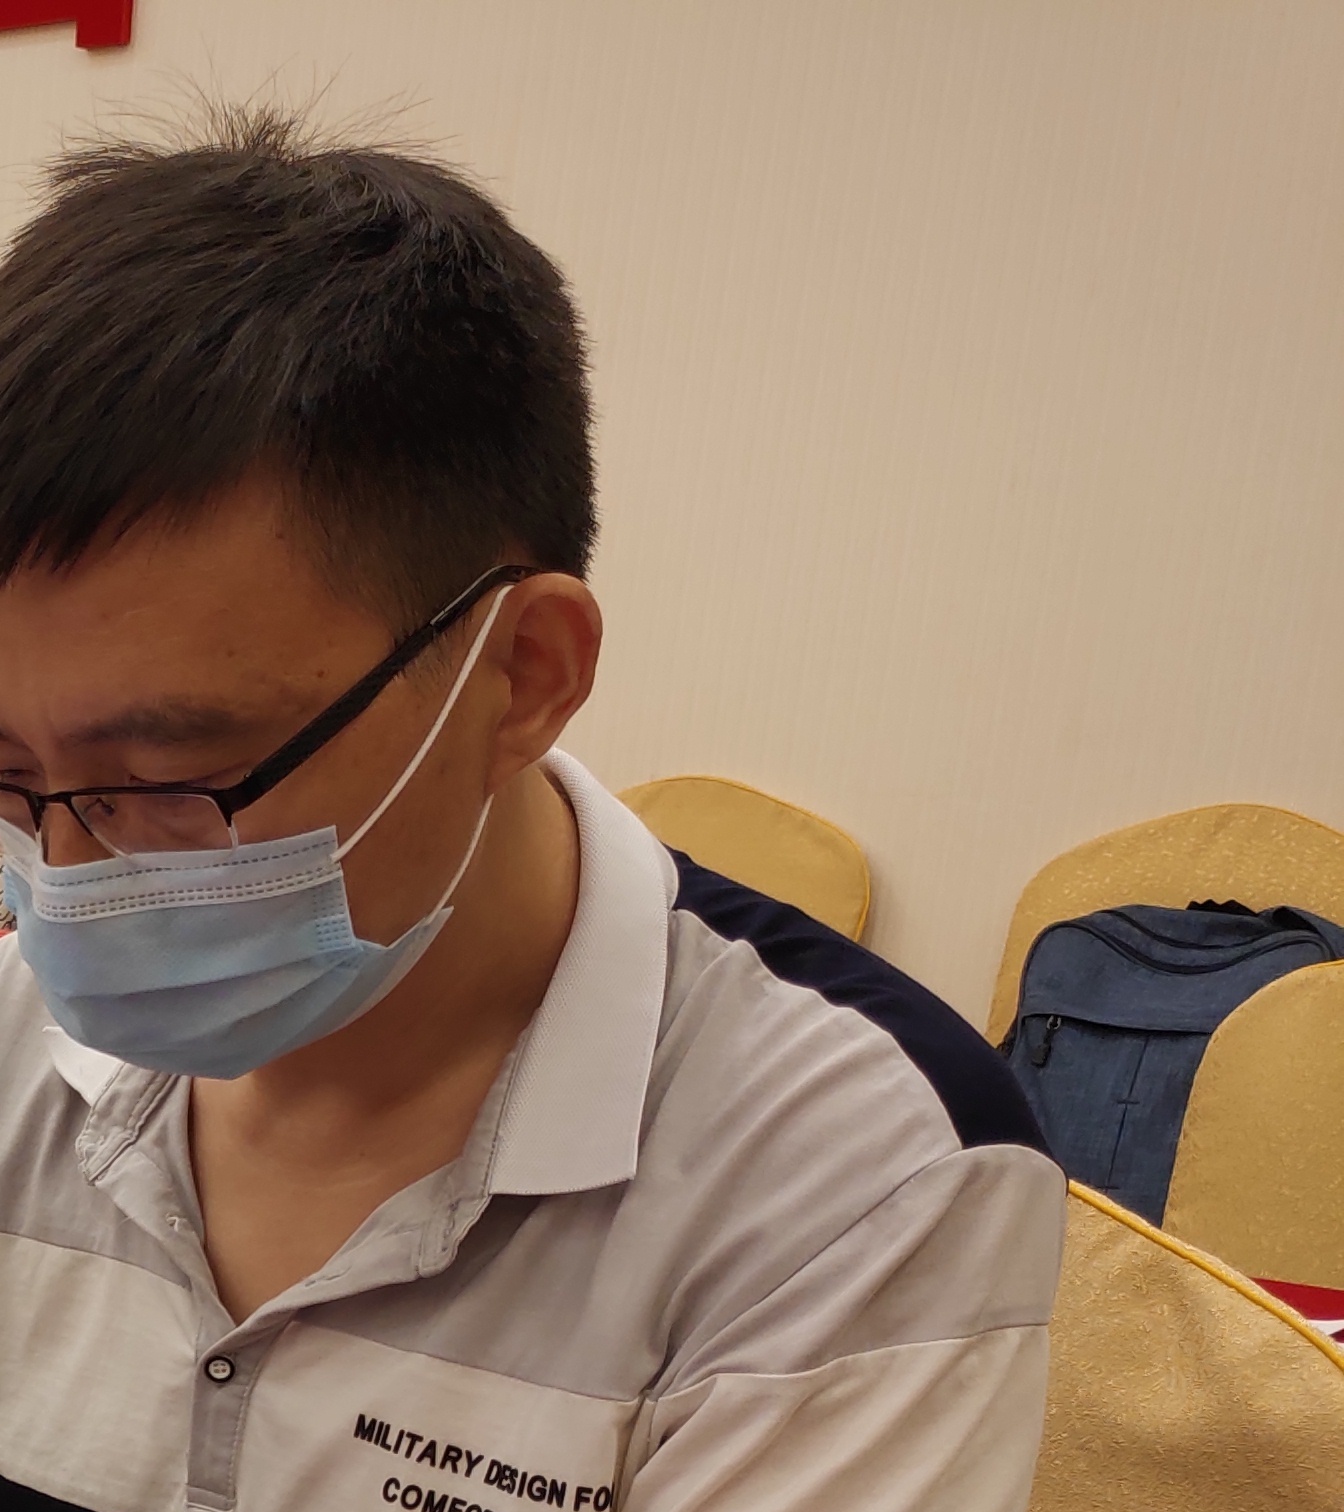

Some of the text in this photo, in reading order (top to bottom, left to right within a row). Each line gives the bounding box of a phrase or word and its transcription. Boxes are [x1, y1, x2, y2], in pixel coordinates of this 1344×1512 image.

[353, 1413, 615, 1512] MILITARY DESIGN FO
